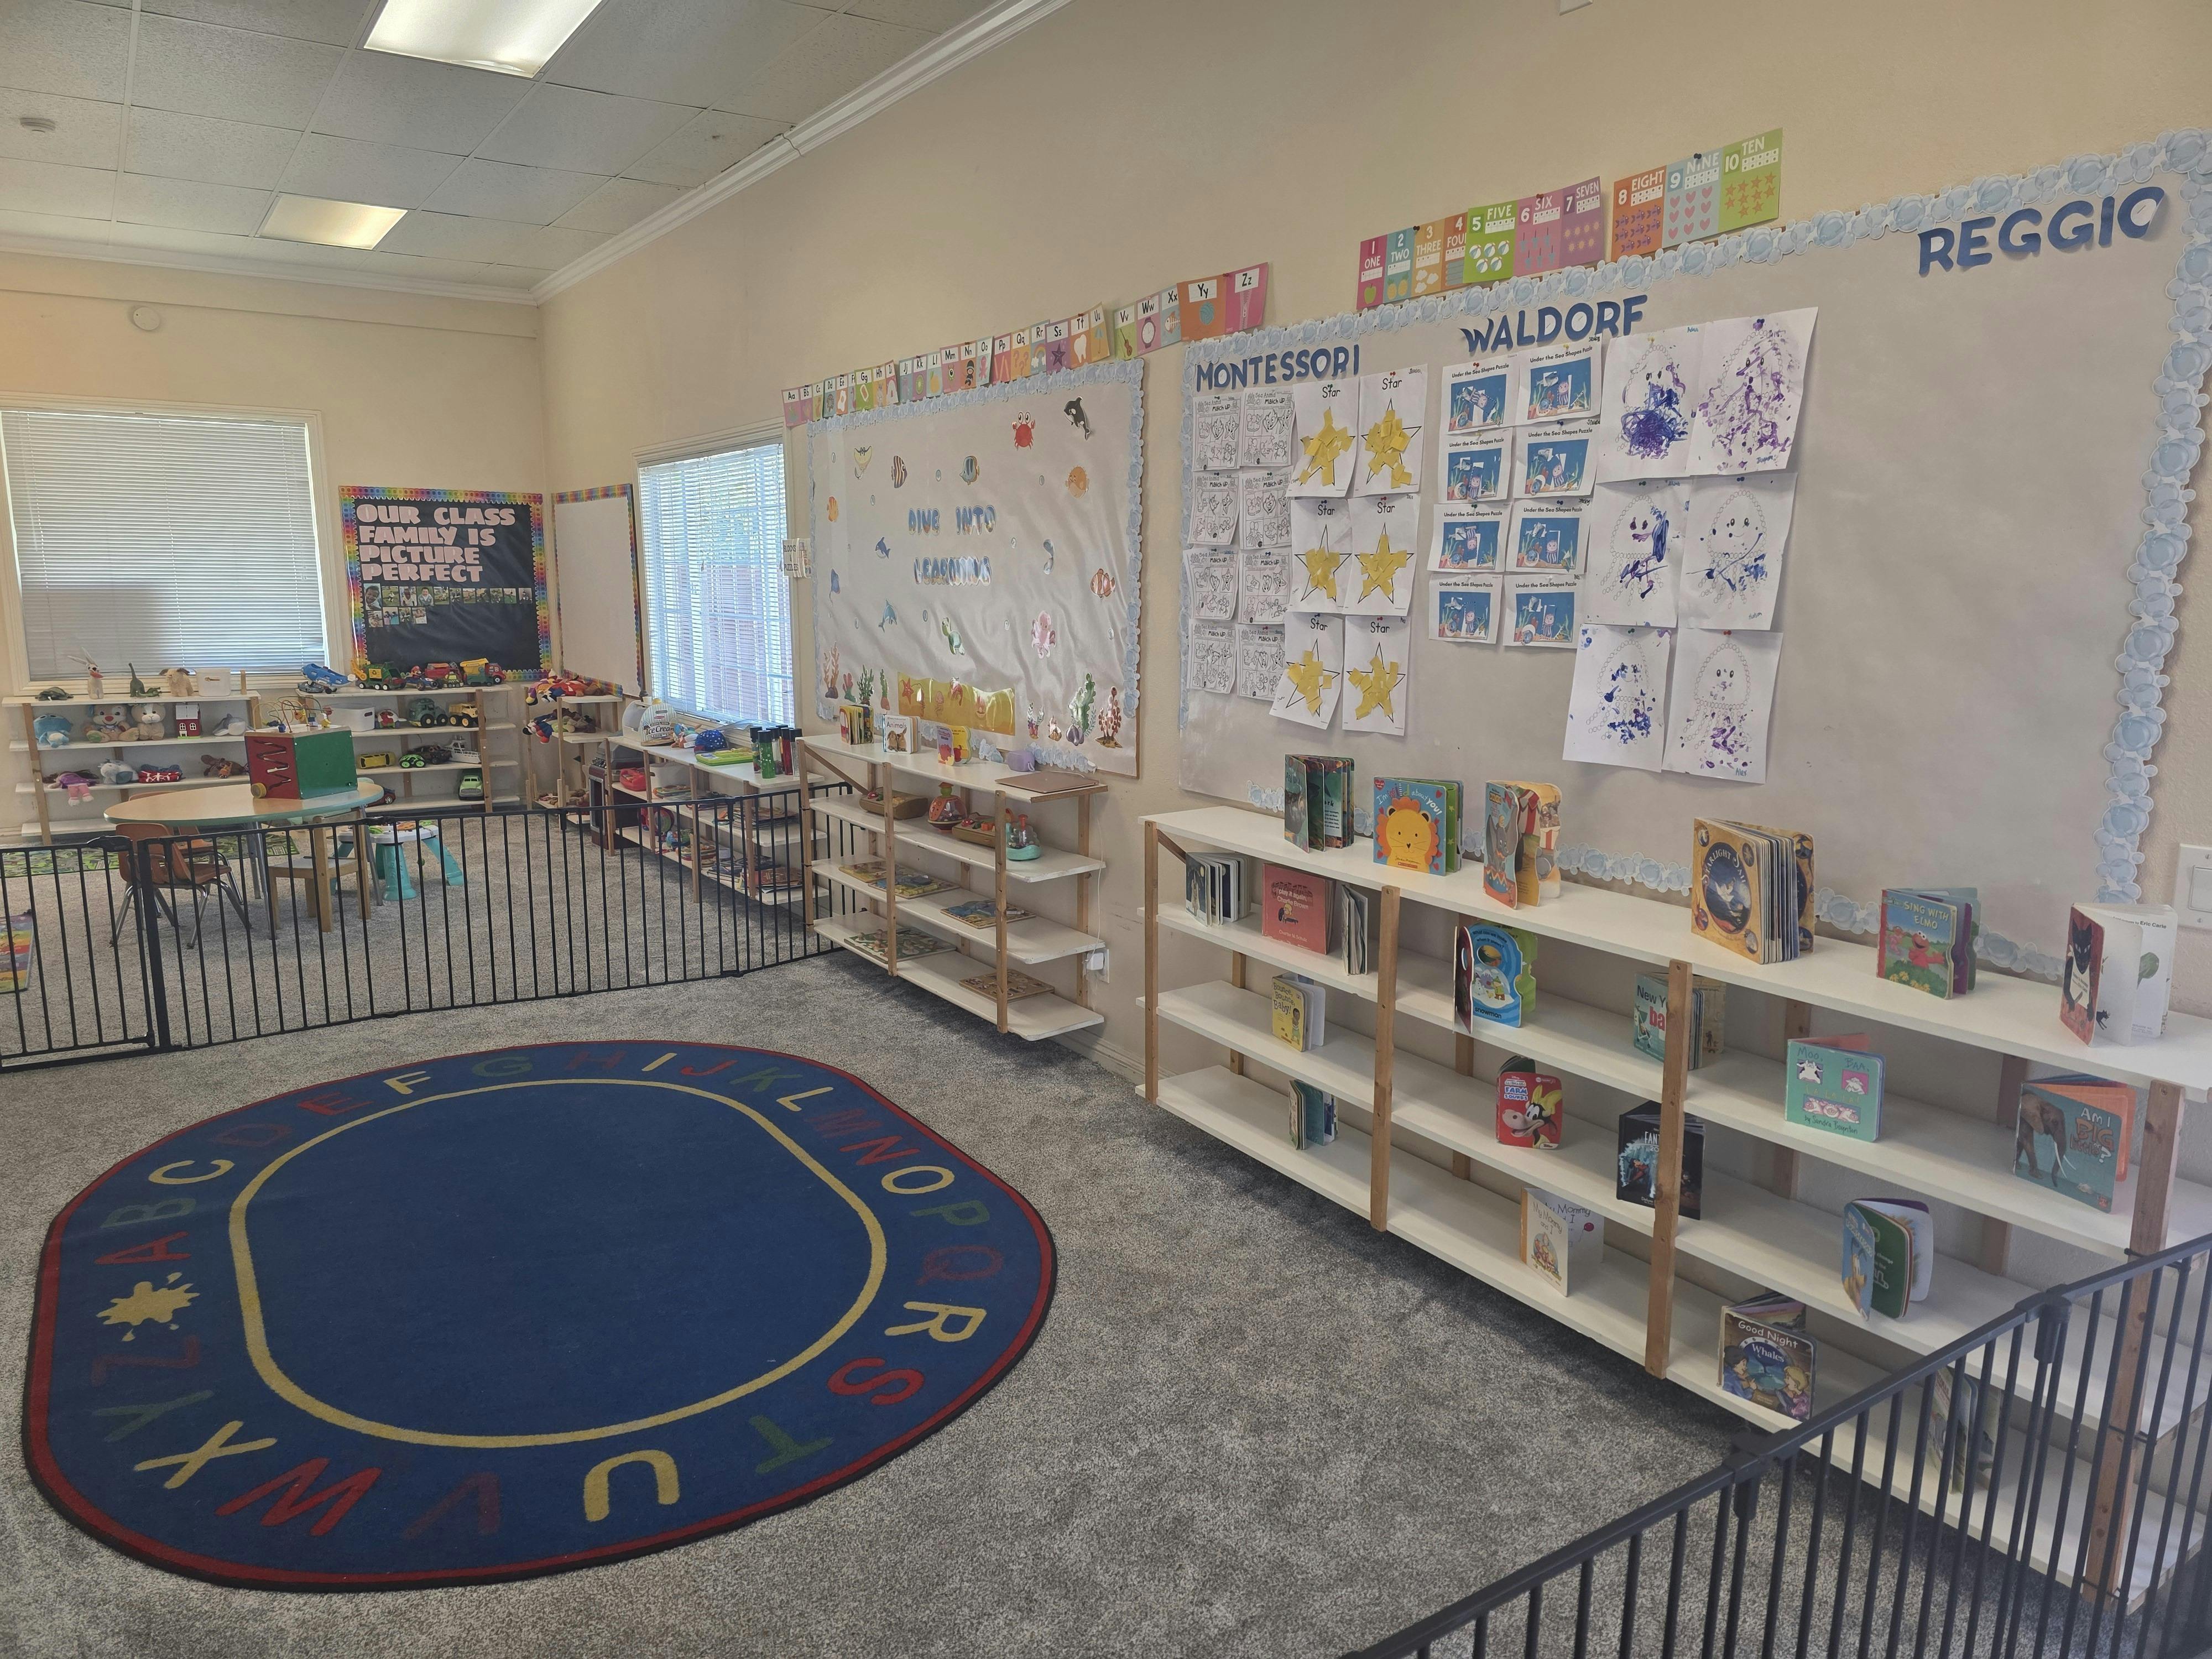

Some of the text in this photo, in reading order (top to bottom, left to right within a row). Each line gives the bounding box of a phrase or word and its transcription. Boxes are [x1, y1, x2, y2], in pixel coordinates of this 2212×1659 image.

[1725, 137, 1765, 173] 10 TEN
[1670, 152, 1719, 189] 9 NINE
[1566, 181, 1599, 212] 7 SEVEN
[1618, 170, 1665, 205] 8 EIGHT
[1472, 205, 1512, 231] 5 FIVE
[1521, 196, 1552, 222] 6 SIX
[1455, 217, 1463, 231] 4
[1917, 186, 2164, 277] REGGIO
[1391, 233, 1410, 262] 2 TWO
[1416, 225, 1442, 255] 3 THREE
[1364, 241, 1380, 269] 1 ONE
[804, 388, 810, 397] Bb
[827, 381, 833, 389] Dd
[839, 378, 845, 387] Ee
[860, 372, 868, 383] Gg
[877, 369, 883, 378] Hh
[916, 359, 923, 369] Kk
[945, 352, 956, 360] Mm
[964, 346, 972, 356] Nn
[981, 342, 988, 352] Oo
[999, 340, 1006, 351] Pp
[1016, 333, 1025, 346] Qq
[1036, 327, 1043, 337] Rr
[1054, 326, 1062, 337] Ss
[1120, 311, 1129, 323] Vv
[1142, 301, 1154, 314] Ww
[1168, 290, 1178, 304] Xx
[1197, 283, 1209, 299] Yy
[1241, 273, 1252, 286] Zz
[1460, 294, 1648, 352] WALDORF
[1196, 344, 1359, 392] MONTESSORI
[1322, 386, 1340, 398] Star
[1383, 378, 1402, 390] Star
[356, 504, 515, 526] OUR CLASS
[956, 505, 996, 535] INTO
[1318, 504, 1335, 516] Star
[1377, 502, 1395, 514] Star
[359, 525, 496, 546] FAMILY IS
[359, 545, 480, 564] PICTURE
[361, 564, 483, 582] PERFECT
[1310, 618, 1328, 631] Star
[1370, 622, 1390, 634] Star
[1411, 788, 1427, 801] about
[1426, 798, 1442, 815] YOU!
[1702, 849, 1731, 884] STARLIGHT
[1277, 896, 1309, 911] Charlie Brown
[1279, 888, 1288, 896] play
[1904, 901, 1925, 914] SING
[1928, 908, 1949, 921] WITH
[1914, 915, 1938, 929] ELMO
[1273, 982, 1293, 997] Bounce,
[1275, 992, 1296, 1006] Bounce,
[1637, 985, 1657, 1004] New
[1273, 999, 1291, 1015] Baby!
[1475, 1006, 1502, 1019] snowman
[472, 1056, 533, 1077] G
[641, 1052, 677, 1071] I
[681, 1060, 738, 1076] J
[383, 1071, 431, 1094] F
[729, 1067, 803, 1092] K
[298, 1092, 374, 1115] E
[776, 1087, 833, 1112] L
[1804, 1115, 1858, 1134] by Sandra Boynton
[2076, 1117, 2114, 1149] BIG
[839, 1136, 921, 1165] N
[148, 1159, 235, 1185] C
[881, 1166, 954, 1194] O
[100, 1198, 196, 1228] B
[910, 1200, 990, 1225] P
[1533, 1202, 1542, 1217] My
[1558, 1203, 1591, 1217] Mommy
[95, 1231, 191, 1264] A
[918, 1245, 1003, 1285] Q
[885, 1301, 987, 1342] R
[1739, 1321, 1798, 1349] Good Night
[1752, 1343, 1785, 1363] Whales
[827, 1357, 925, 1405] S
[91, 1390, 215, 1442] Y
[134, 1421, 277, 1490] X
[749, 1415, 833, 1476] T
[216, 1458, 382, 1536] W
[585, 1449, 680, 1522] U
